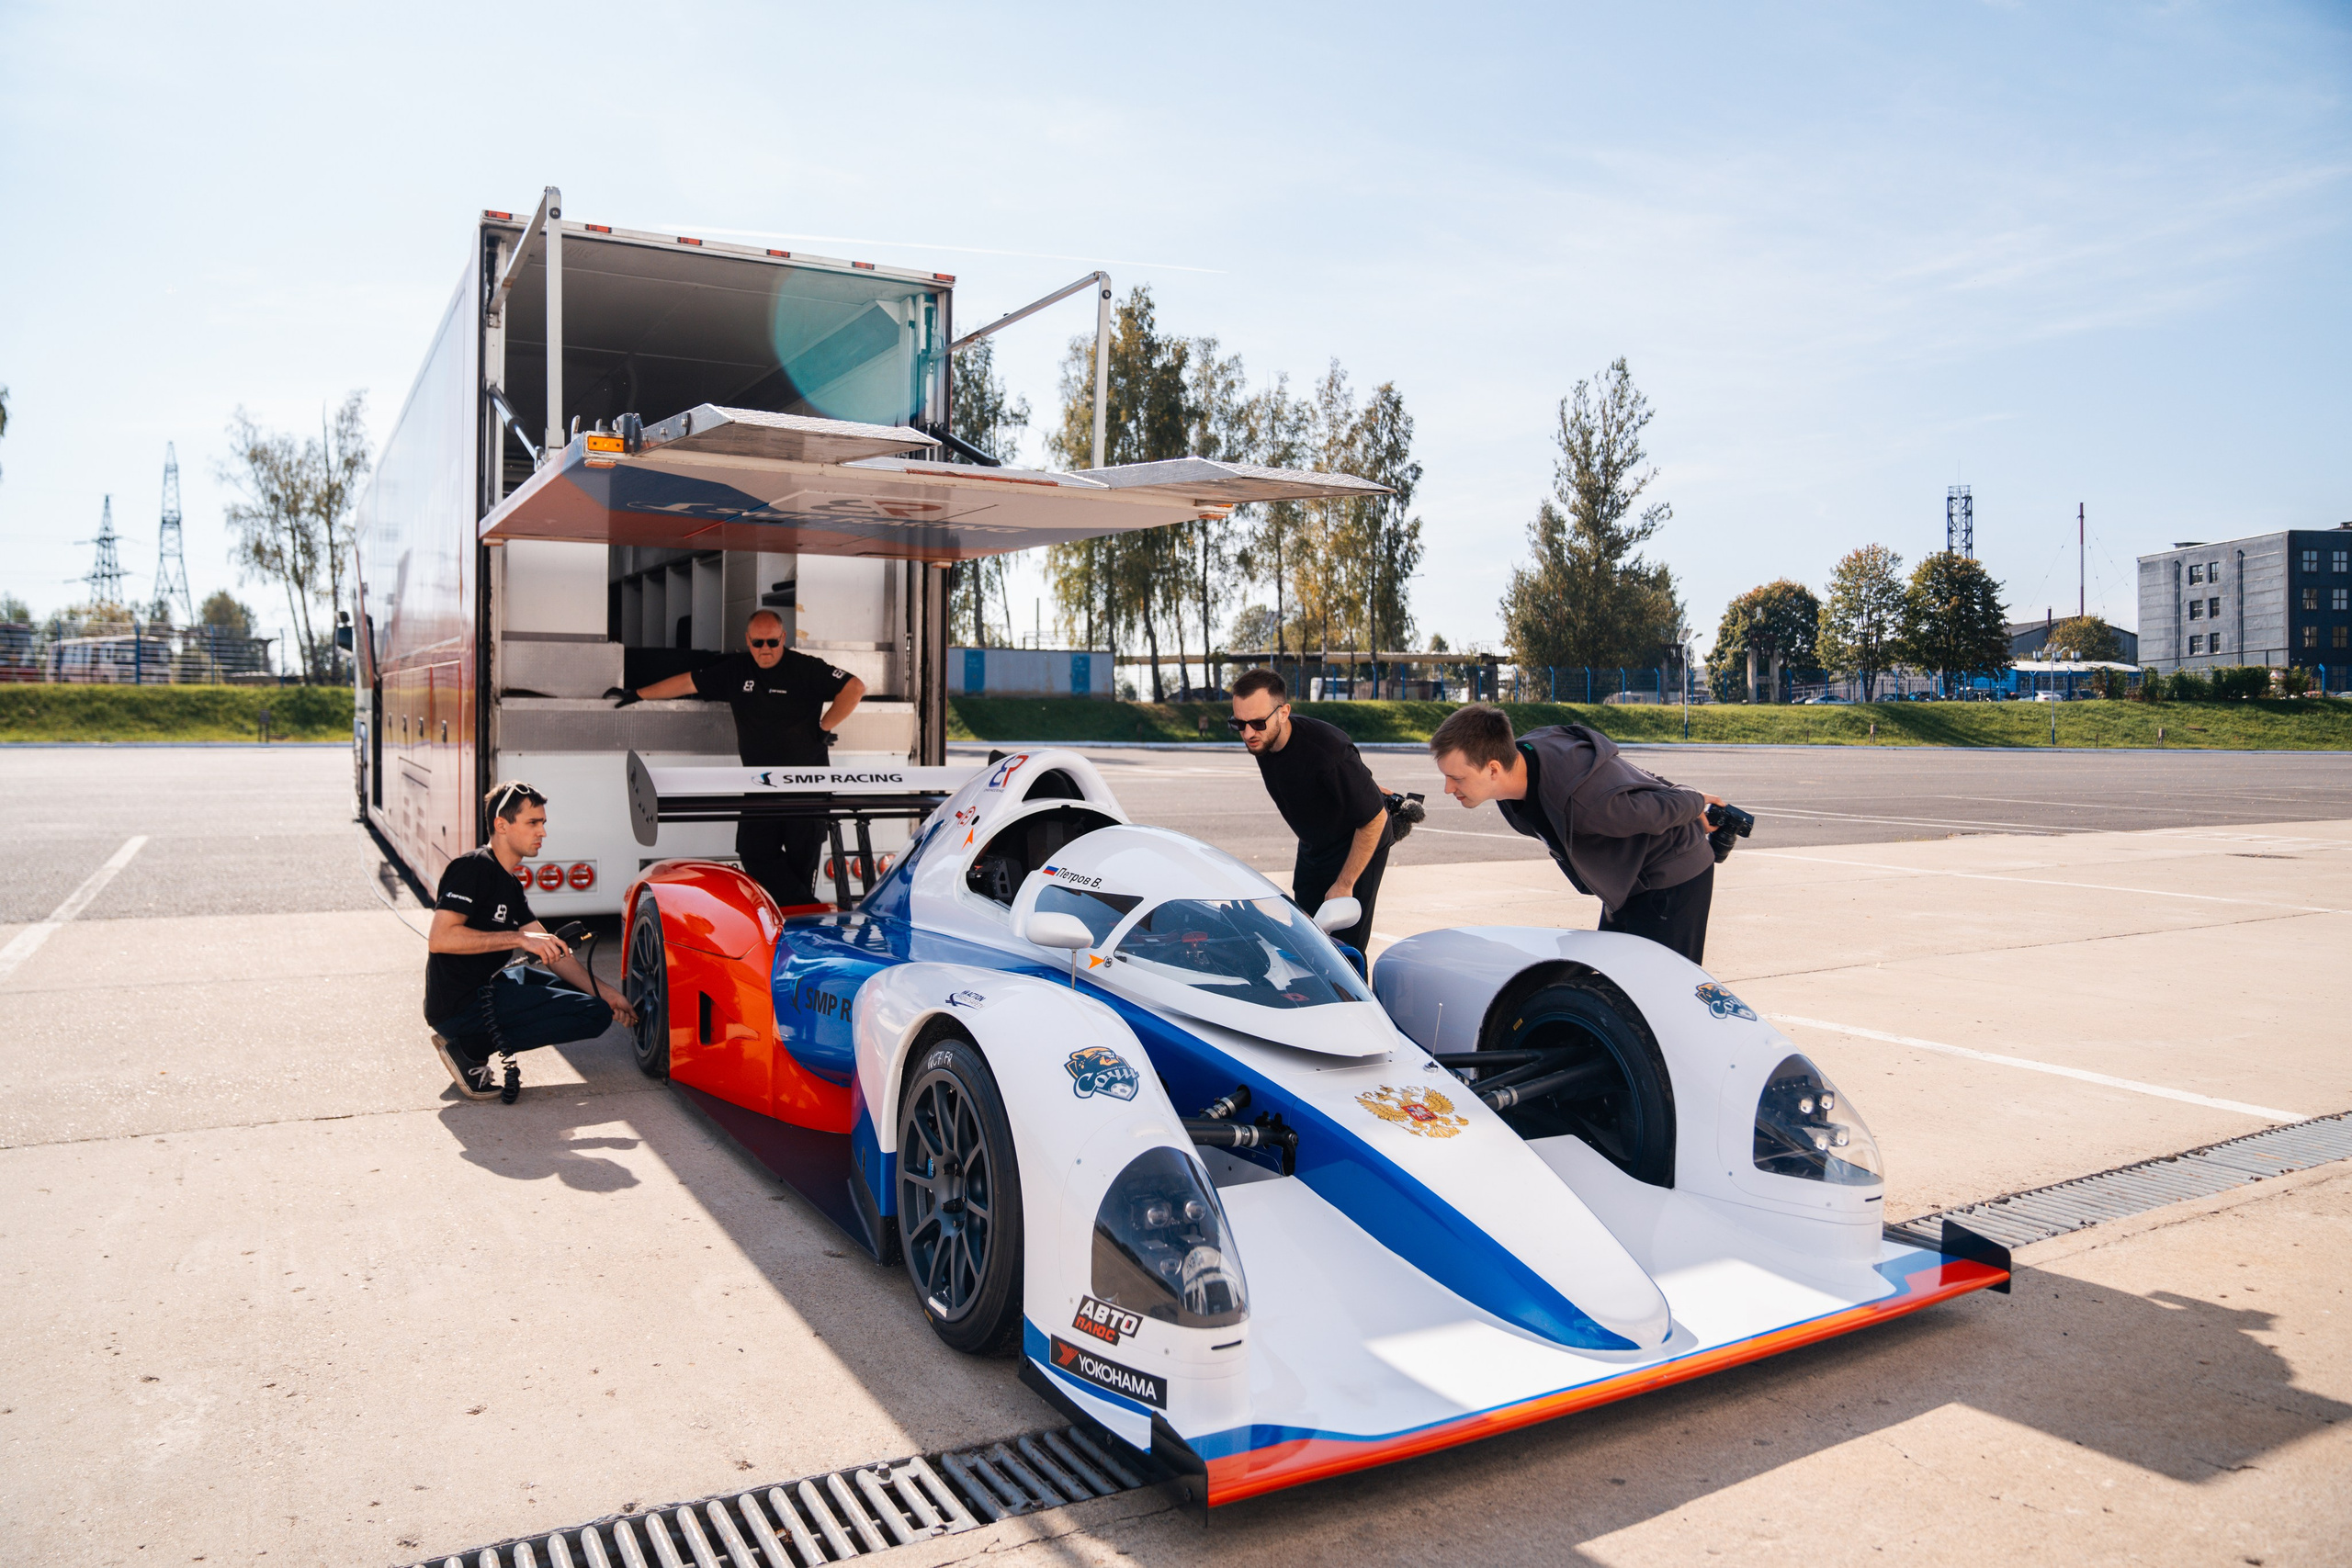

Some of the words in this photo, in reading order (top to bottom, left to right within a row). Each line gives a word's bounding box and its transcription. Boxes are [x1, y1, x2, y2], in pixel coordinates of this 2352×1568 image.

[782, 774, 826, 784] SMP
[831, 773, 903, 783] RACING
[1056, 867, 1091, 885] Петров
[805, 987, 838, 1016] SMP
[1075, 1315, 1115, 1342] ПЛЮС
[1079, 1299, 1138, 1335] АВТО
[1078, 1353, 1157, 1401] YOKOHAMA
